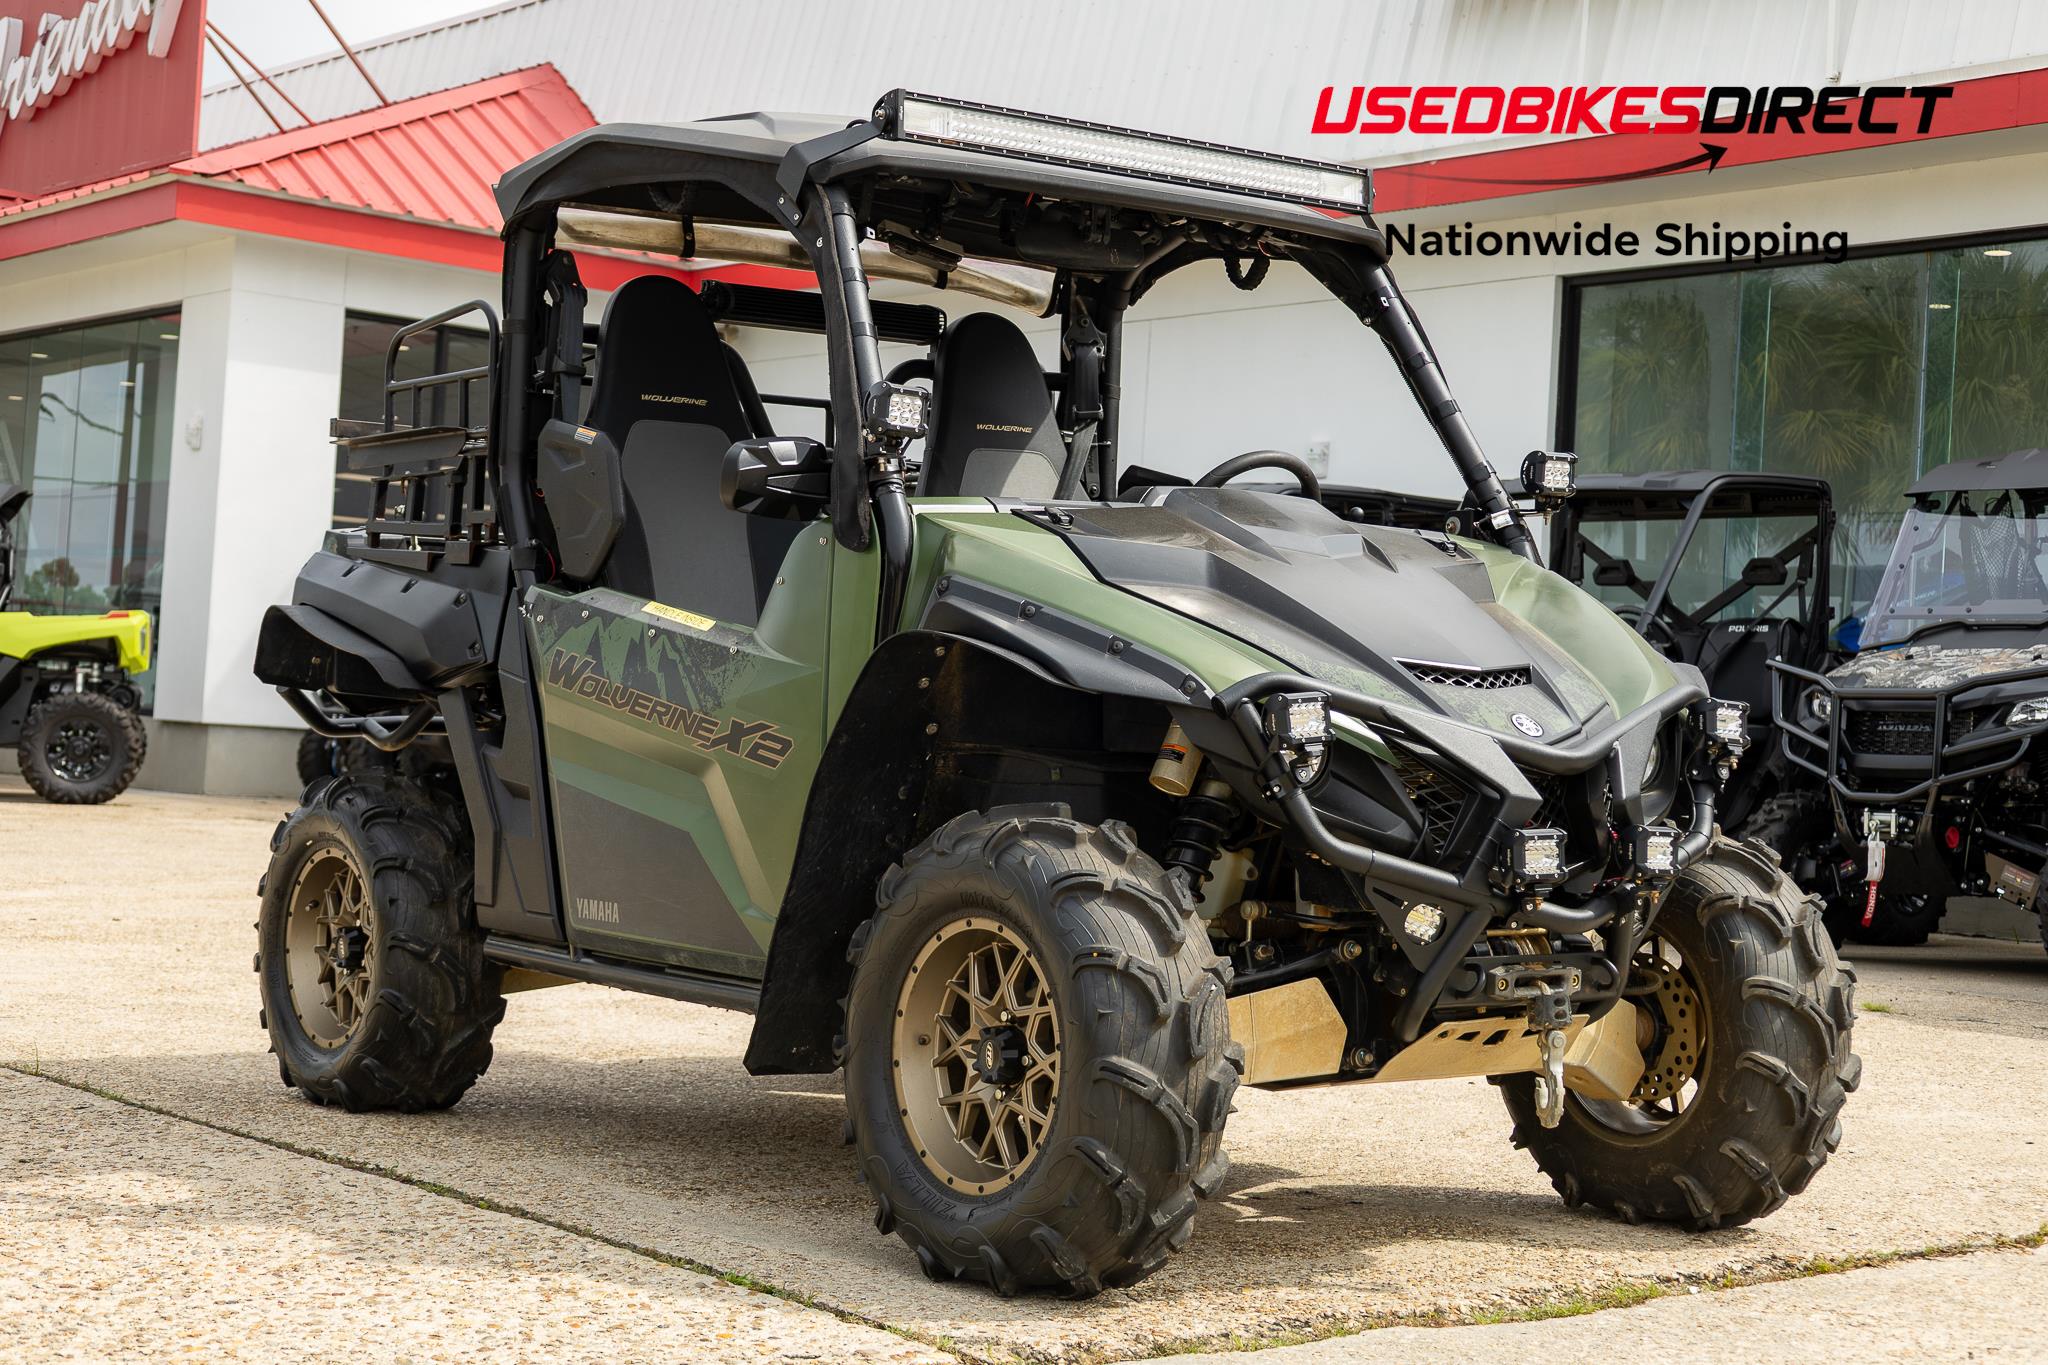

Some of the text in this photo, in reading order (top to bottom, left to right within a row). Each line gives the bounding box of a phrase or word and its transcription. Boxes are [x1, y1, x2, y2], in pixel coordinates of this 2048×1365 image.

[641, 394, 709, 406] WOLVERINE
[976, 423, 1033, 434] WOLVERINE
[576, 898, 620, 924] YAMAHA
[1864, 888, 1877, 919] HONDA
